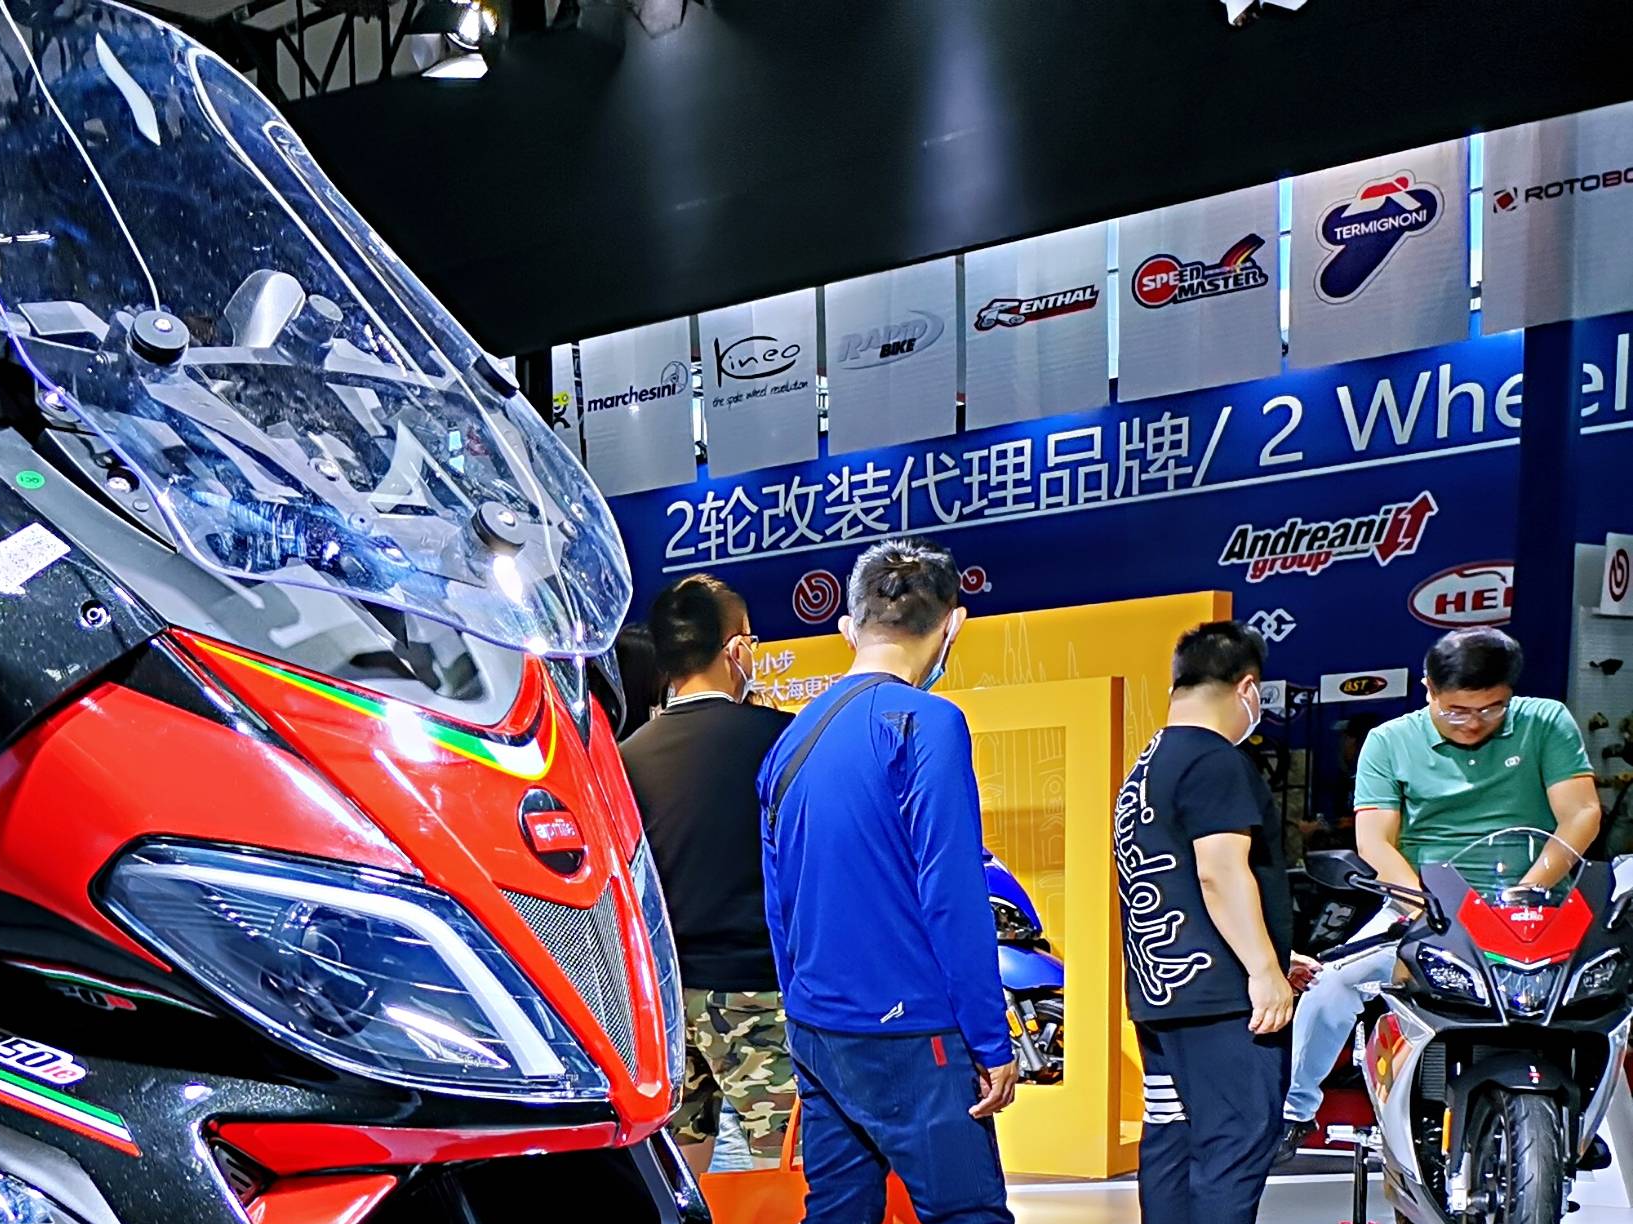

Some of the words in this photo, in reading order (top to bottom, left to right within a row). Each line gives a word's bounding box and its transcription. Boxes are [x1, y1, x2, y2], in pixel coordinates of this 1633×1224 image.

[1334, 209, 1428, 240] TERMIGNONI
[1142, 265, 1203, 292] SPEED
[1178, 269, 1259, 299] MASTER
[879, 337, 916, 359] BIKE
[587, 383, 677, 412] marchesini
[1222, 506, 1394, 562] Andreani
[1250, 550, 1333, 580] group
[1343, 679, 1369, 692] BST
